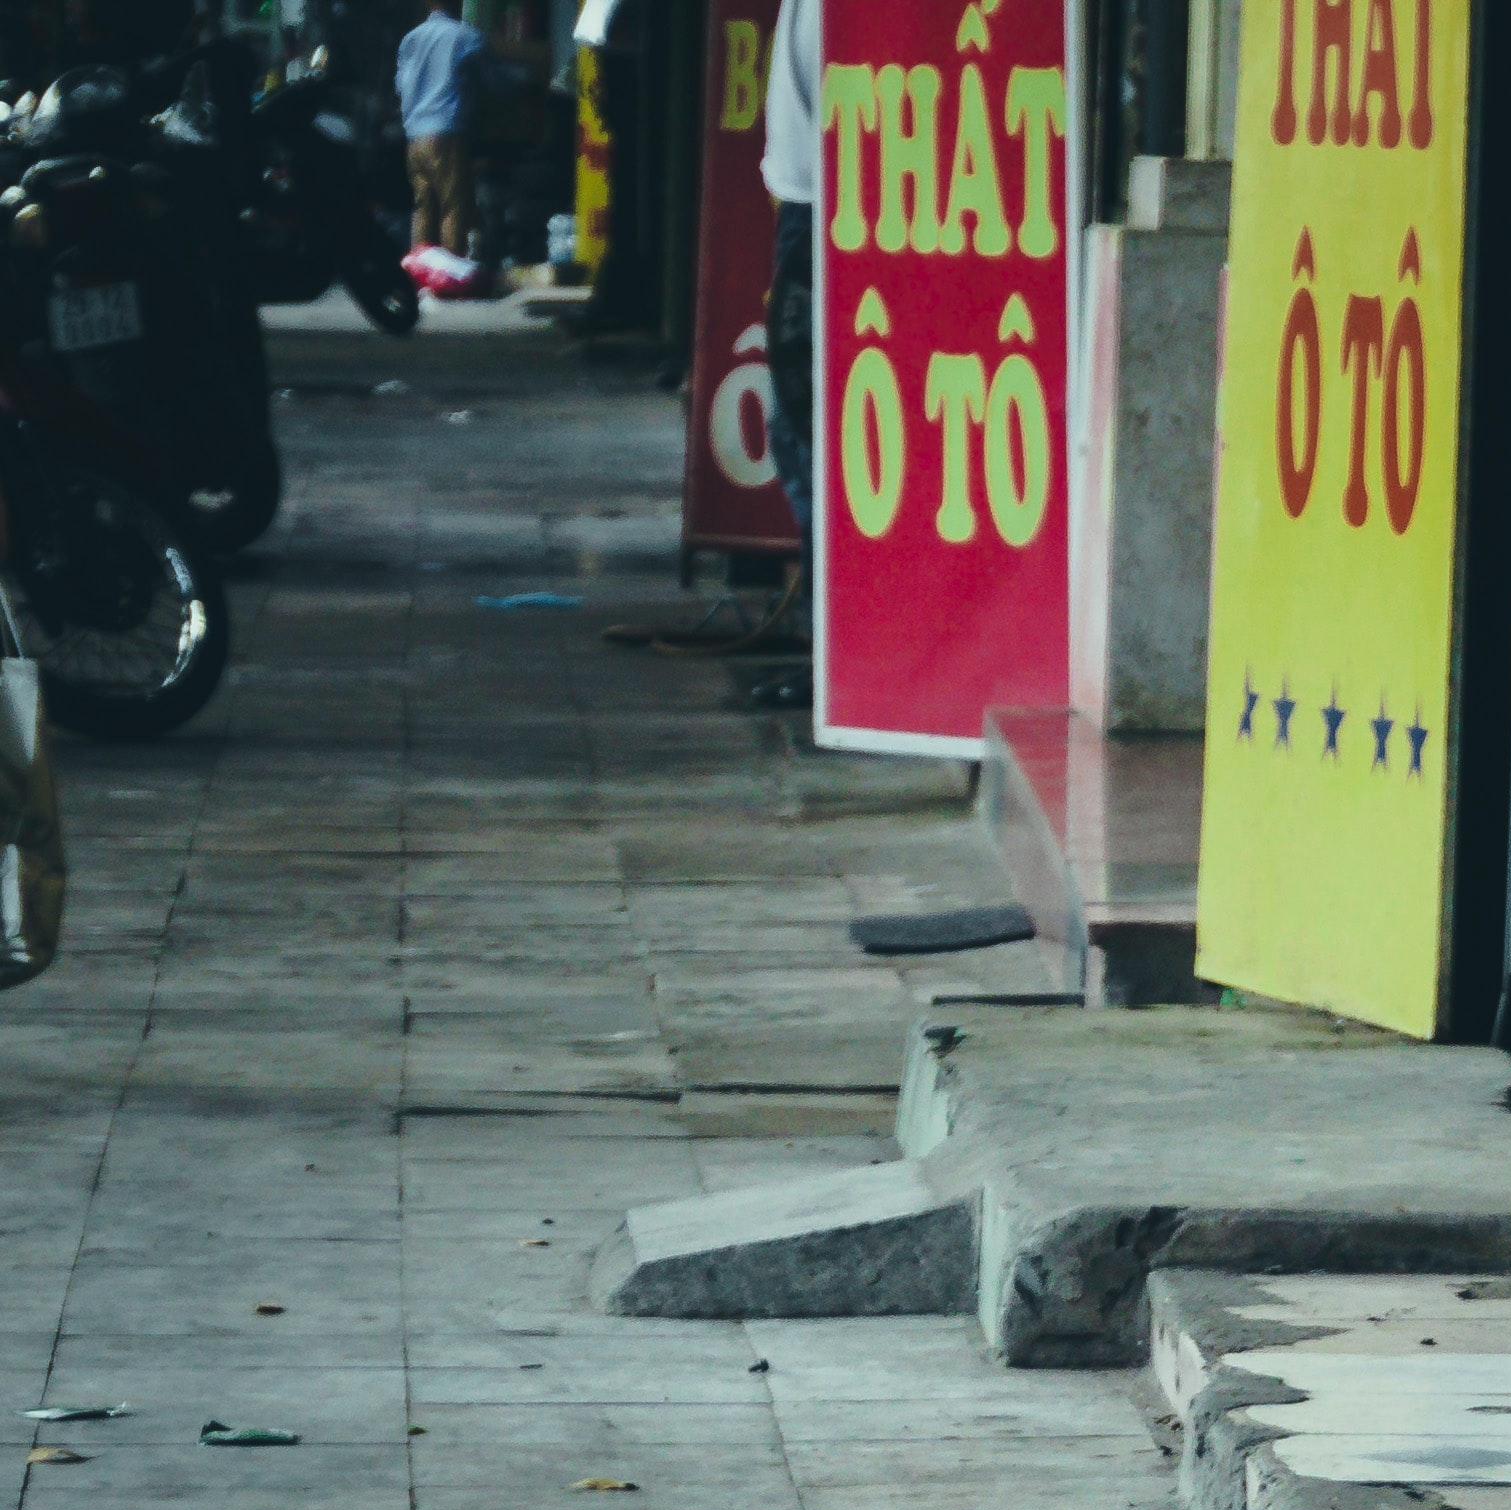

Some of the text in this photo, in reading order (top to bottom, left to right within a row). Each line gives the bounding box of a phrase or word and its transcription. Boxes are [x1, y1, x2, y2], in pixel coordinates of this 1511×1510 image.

[842, 286, 1050, 547] Ô TÔ
[1276, 225, 1426, 535] Ô TÔ
